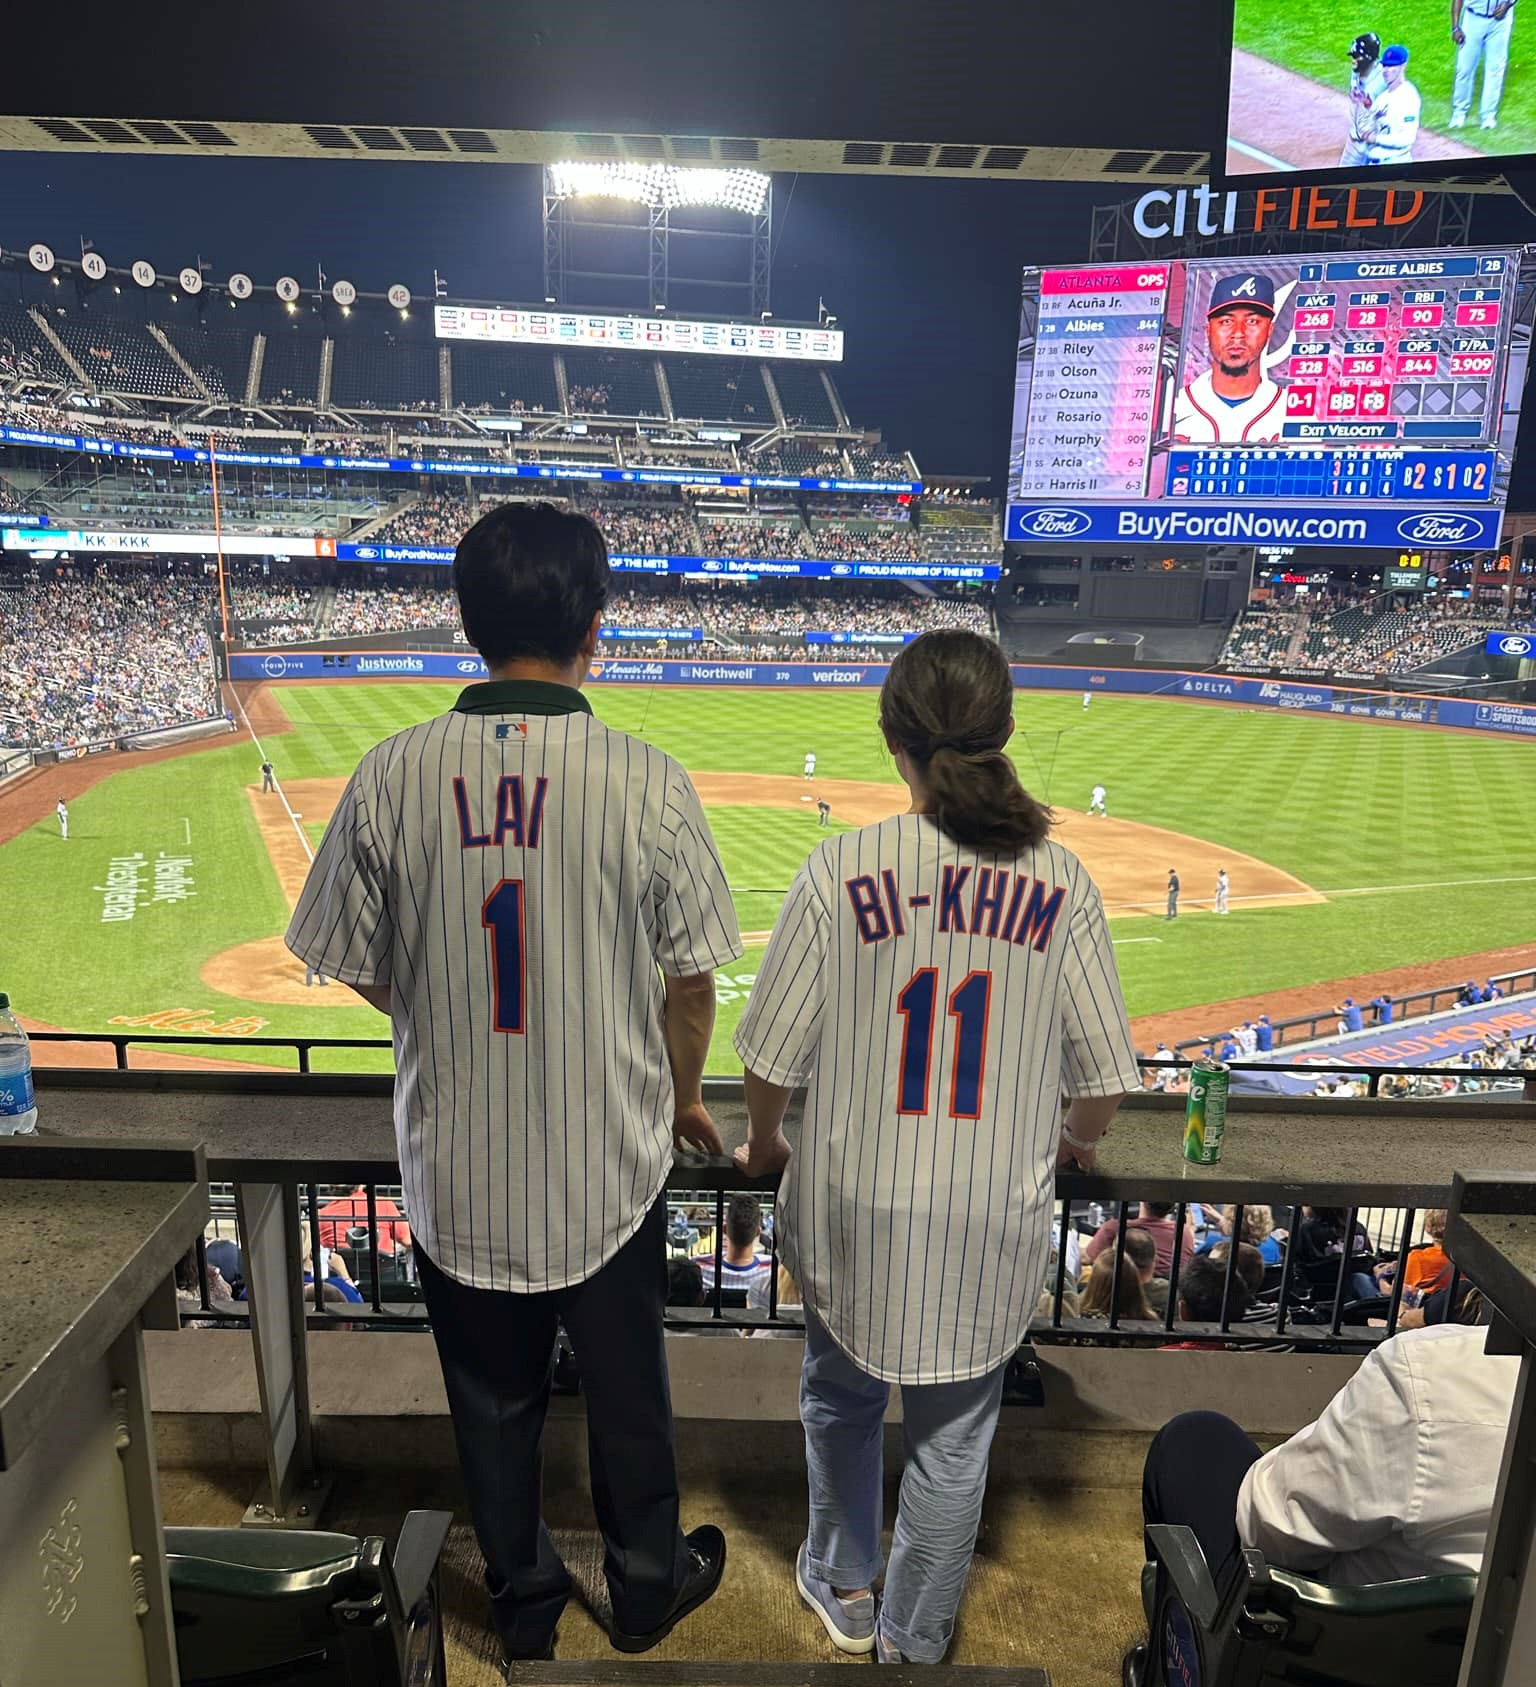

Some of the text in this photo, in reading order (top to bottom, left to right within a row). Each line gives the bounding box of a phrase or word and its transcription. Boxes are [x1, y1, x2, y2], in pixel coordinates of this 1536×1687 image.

[1253, 187, 1424, 233] FIELD
[35, 251, 49, 265] 31
[88, 259, 101, 272] 41
[1357, 264, 1396, 277] OZZIE
[1400, 263, 1444, 275] ALBIES
[1485, 260, 1501, 272] 2B
[138, 267, 149, 279] 14
[184, 275, 198, 288] 37
[1059, 273, 1165, 289] ATLANTA OPS
[392, 290, 406, 302] 42
[1304, 291, 1485, 306] AVG HR RBI R
[1067, 297, 1106, 309] Acuña
[1108, 297, 1122, 309] Jr.
[1300, 308, 1486, 326] .268 28 90 75
[1065, 320, 1105, 332] Albies
[1063, 343, 1095, 357] Riley
[1299, 340, 1489, 355] OBP SLG OPS P/PA
[1061, 365, 1097, 377] Olson
[1295, 357, 1492, 375] .328 .516 .844 3.909
[1058, 388, 1099, 400] Ozuna
[1287, 393, 1385, 409] 0-1 BB F8
[1056, 411, 1102, 422] Rosario
[1300, 425, 1385, 437] EXIT VELOCITY
[1054, 434, 1102, 447] Murphy
[1051, 457, 1083, 468] Arcia
[1127, 458, 1144, 467] 6-3
[1050, 479, 1086, 490] Harris
[1125, 480, 1141, 490] 6-3
[1032, 511, 1468, 541] Ford BuyFordNow.com Ford
[385, 548, 457, 561] BuyFordNow.c
[611, 558, 669, 569] OF THE METS
[859, 565, 984, 577] PROUD PARTNER OF THE METS
[357, 656, 424, 670] Justworks
[691, 667, 753, 679] Northwell
[775, 671, 790, 681] 370
[812, 669, 861, 682] verizon
[1195, 681, 1232, 694] DELTA
[1278, 699, 1306, 708] GROUP
[1330, 703, 1345, 713] 380
[1492, 712, 1536, 726] SPORTSBOO
[452, 775, 549, 850] LAI
[845, 864, 1067, 953] BI-KHIM
[481, 878, 526, 1035] 1
[107, 1007, 270, 1036] Mets
[896, 967, 993, 1121] 11
[1342, 1012, 1529, 1066] FIELD HOME
